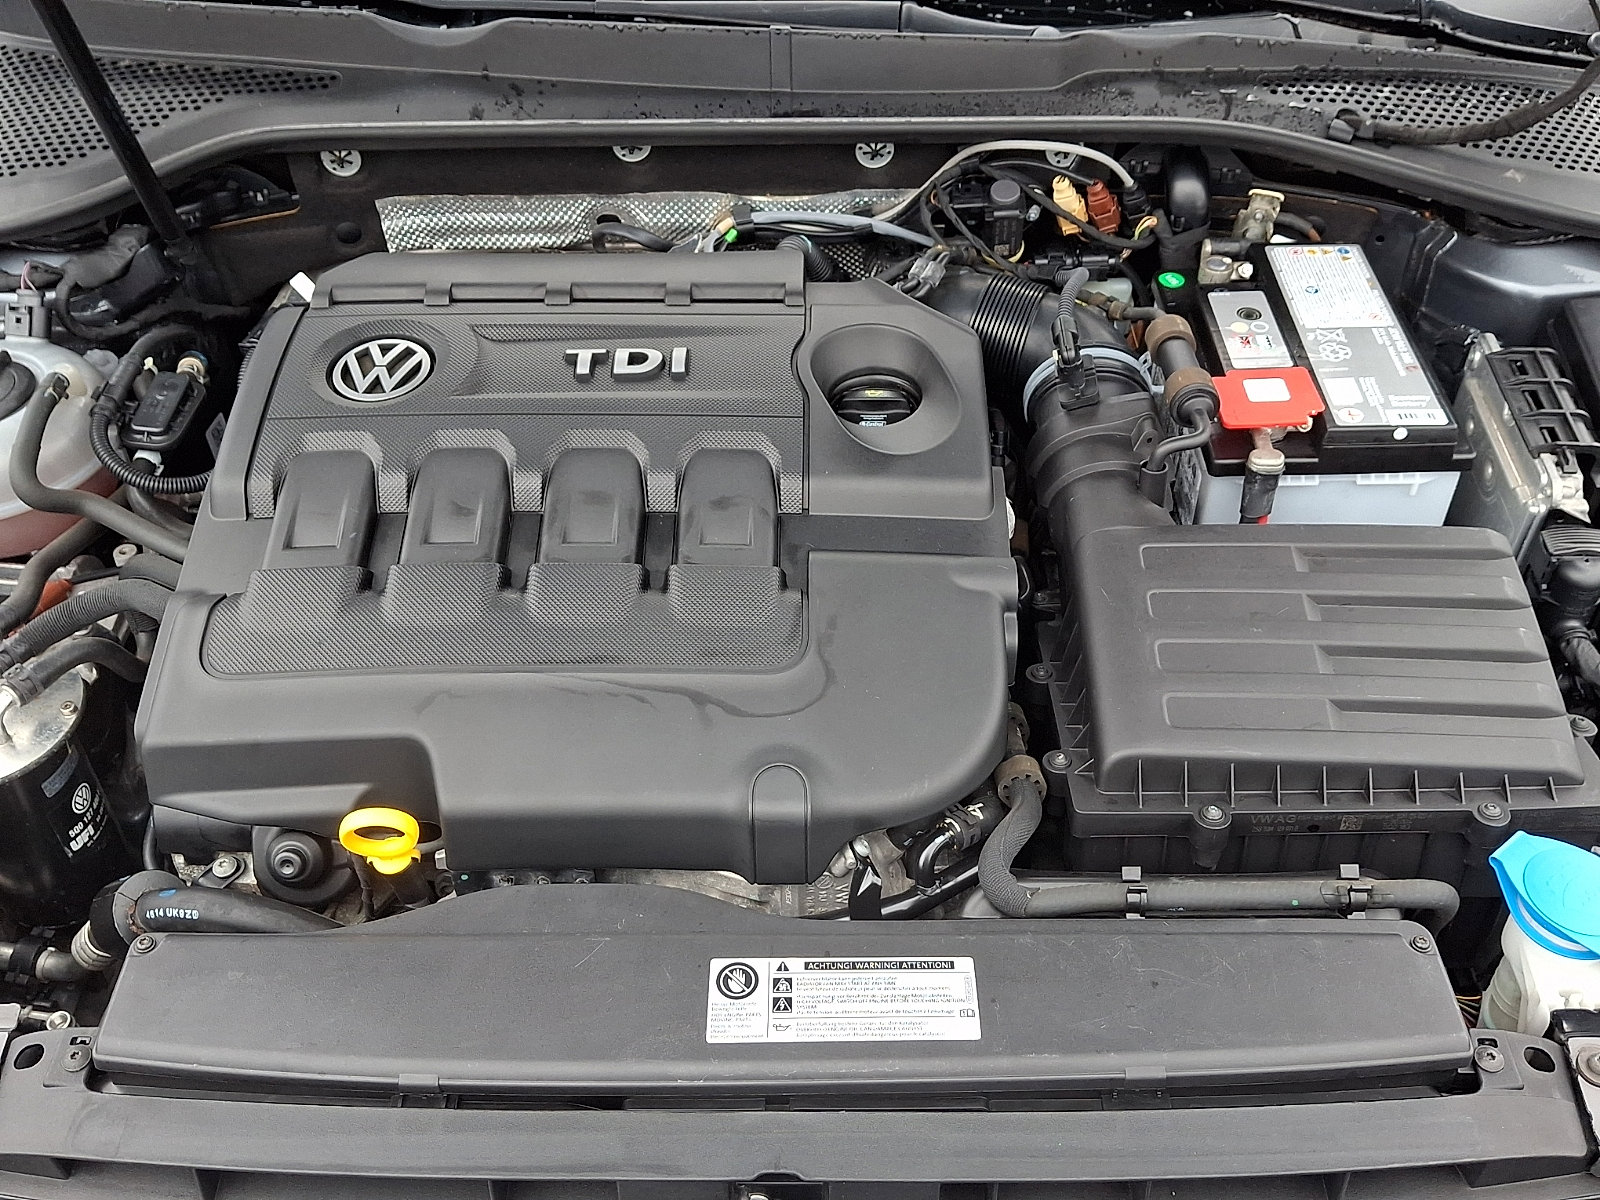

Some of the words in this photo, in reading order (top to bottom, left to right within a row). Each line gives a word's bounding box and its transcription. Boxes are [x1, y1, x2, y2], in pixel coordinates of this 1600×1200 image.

[563, 347, 691, 383] TDI
[70, 824, 95, 851] UFI
[807, 961, 853, 970] ACHTUNG!
[855, 961, 900, 970] WARNING!
[901, 961, 952, 969] ATTENTION!
